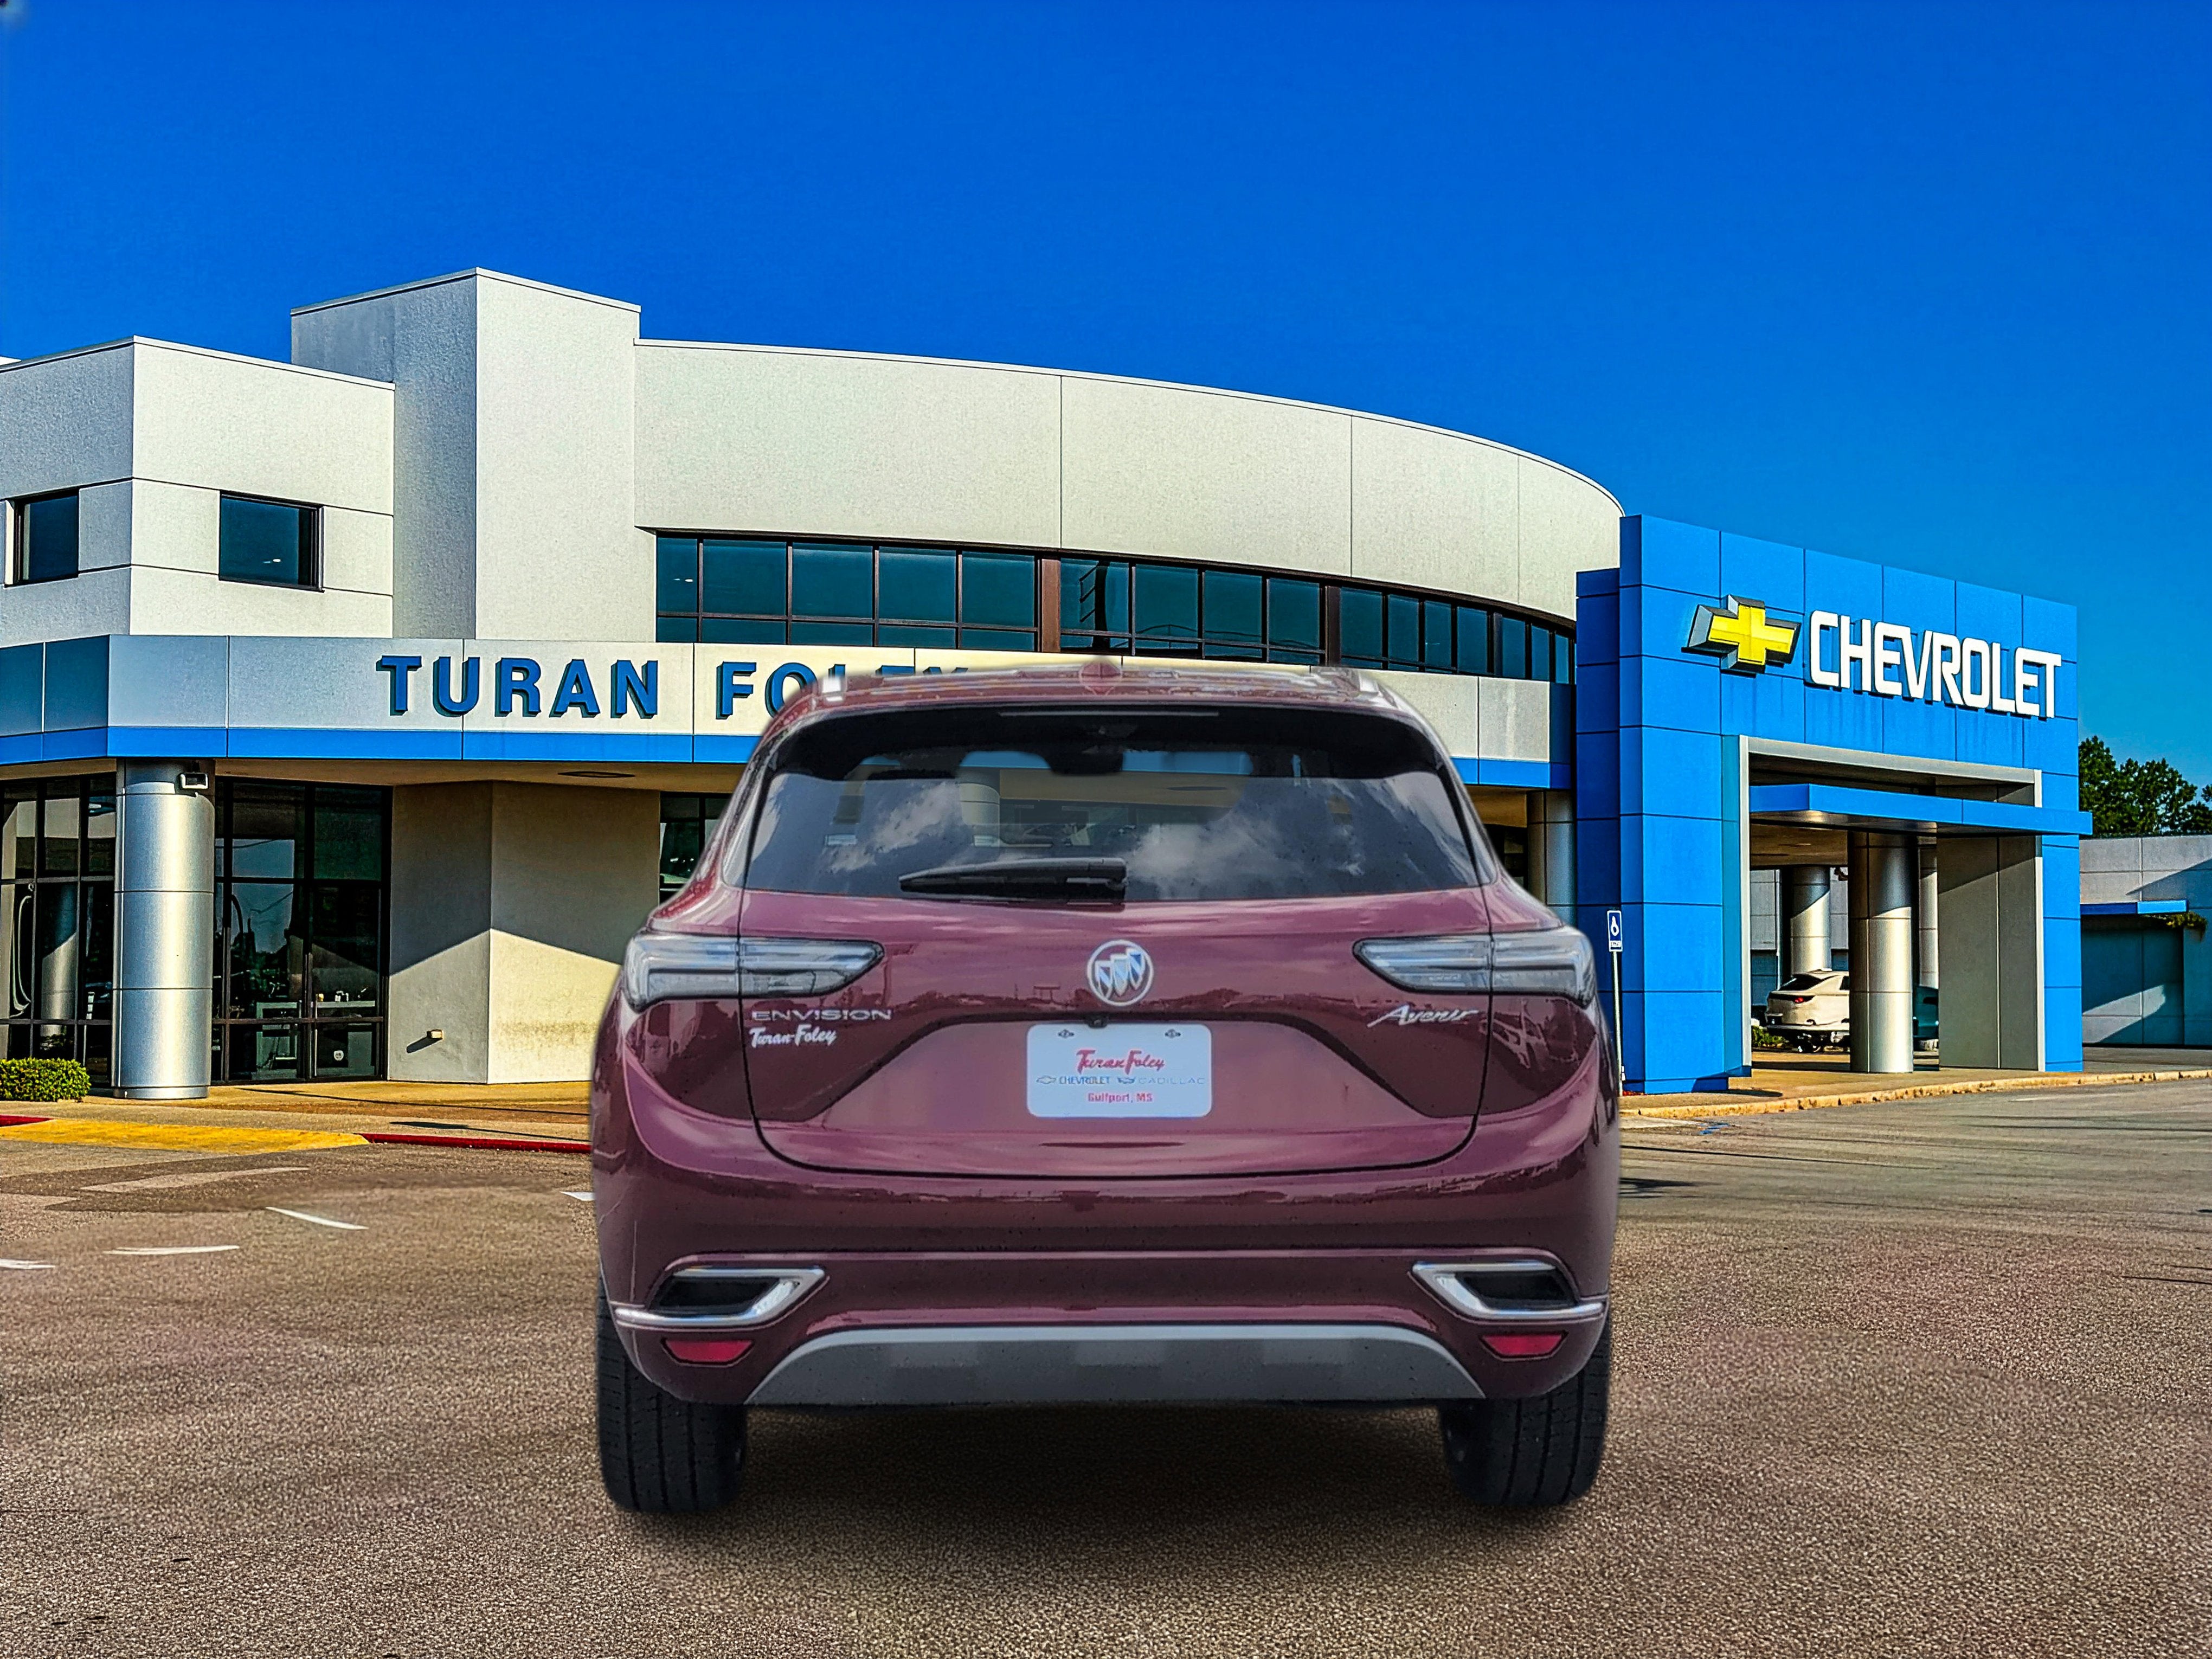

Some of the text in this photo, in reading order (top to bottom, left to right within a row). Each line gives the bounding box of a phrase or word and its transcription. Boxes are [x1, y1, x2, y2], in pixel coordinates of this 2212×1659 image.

[1810, 610, 2062, 718] CHEVROLET
[376, 655, 659, 719] TURAN
[751, 1009, 892, 1021] ENVISION
[1367, 1005, 1479, 1028] Avenir
[794, 1024, 837, 1046] Foley
[1076, 1049, 1165, 1075] Turan Foley
[1059, 1076, 1110, 1084] CHEVROLET
[1088, 1092, 1153, 1103] Gulfport, MS
